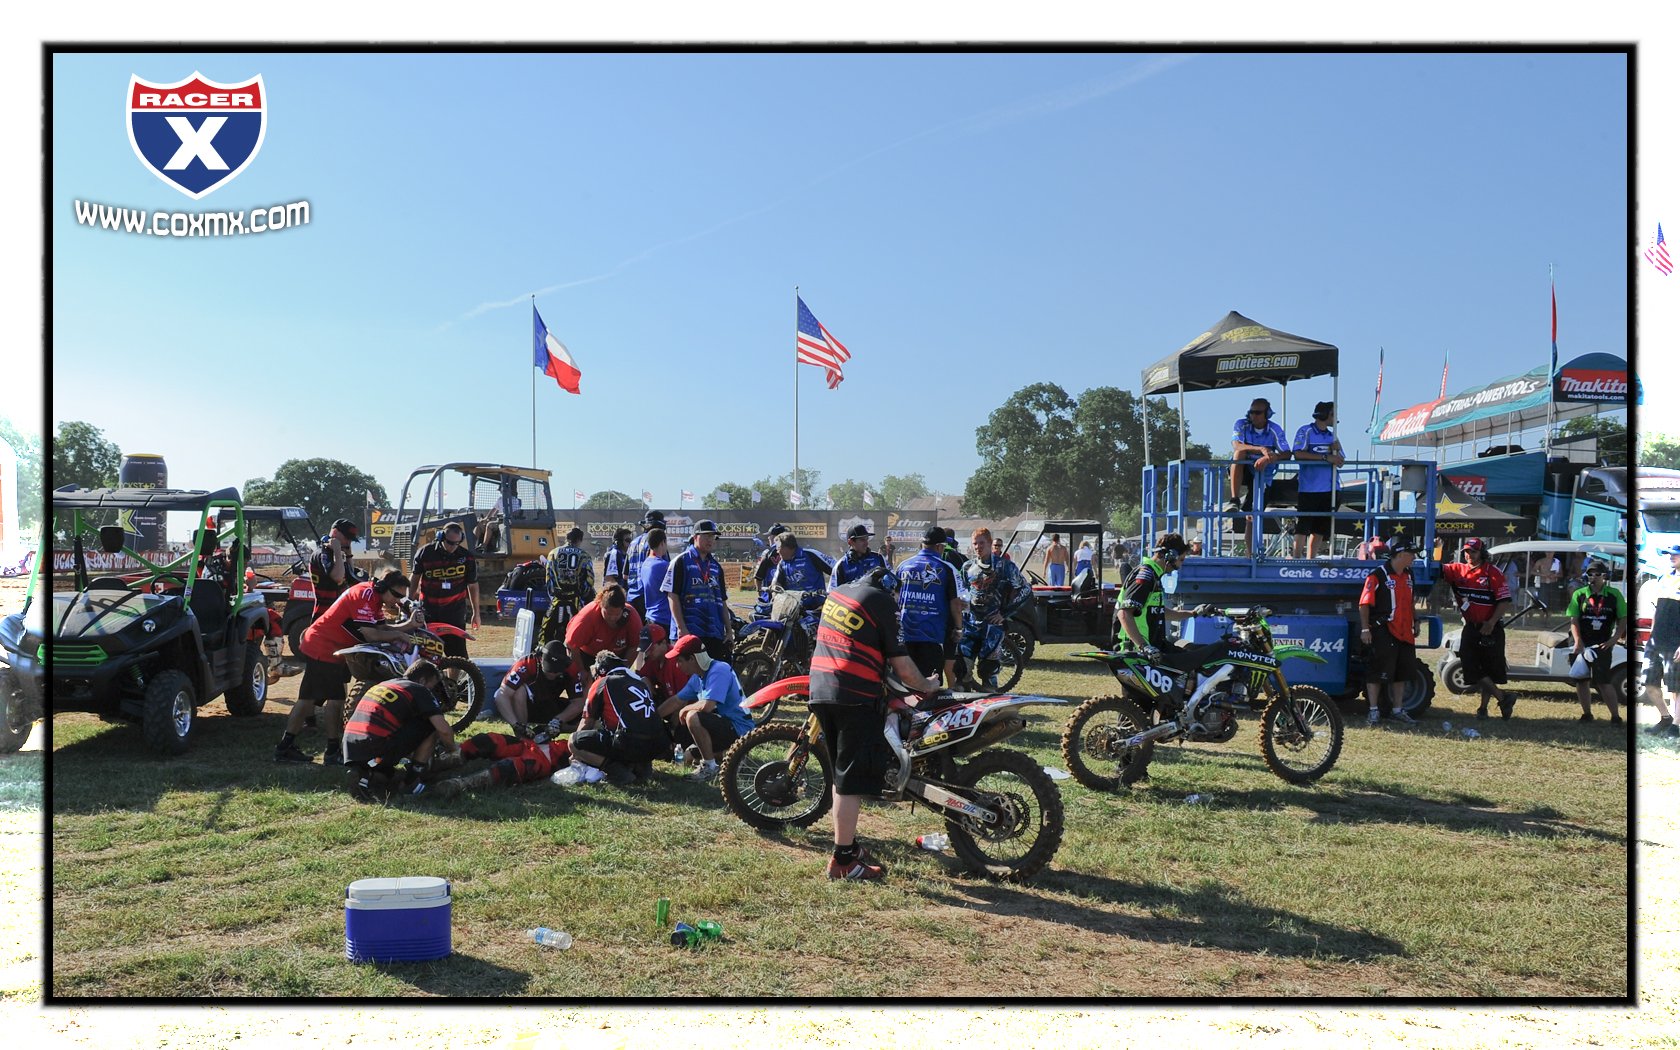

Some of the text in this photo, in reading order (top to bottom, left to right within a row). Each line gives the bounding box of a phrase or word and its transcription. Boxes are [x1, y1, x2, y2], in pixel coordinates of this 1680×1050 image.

[1218, 356, 1298, 371] mototees.com
[1503, 380, 1540, 398] TOOLS
[1567, 392, 1625, 401] makitatools.com
[896, 519, 931, 527] thor
[558, 553, 579, 571] 20
[425, 564, 466, 578] GEICO
[1279, 567, 1313, 578] Genie
[907, 592, 936, 602] YAMAHA
[822, 598, 865, 631] EICO
[1309, 637, 1345, 653] 4x4
[1228, 650, 1277, 666] MONSTER
[1144, 665, 1173, 693] 108
[942, 708, 976, 730] 243
